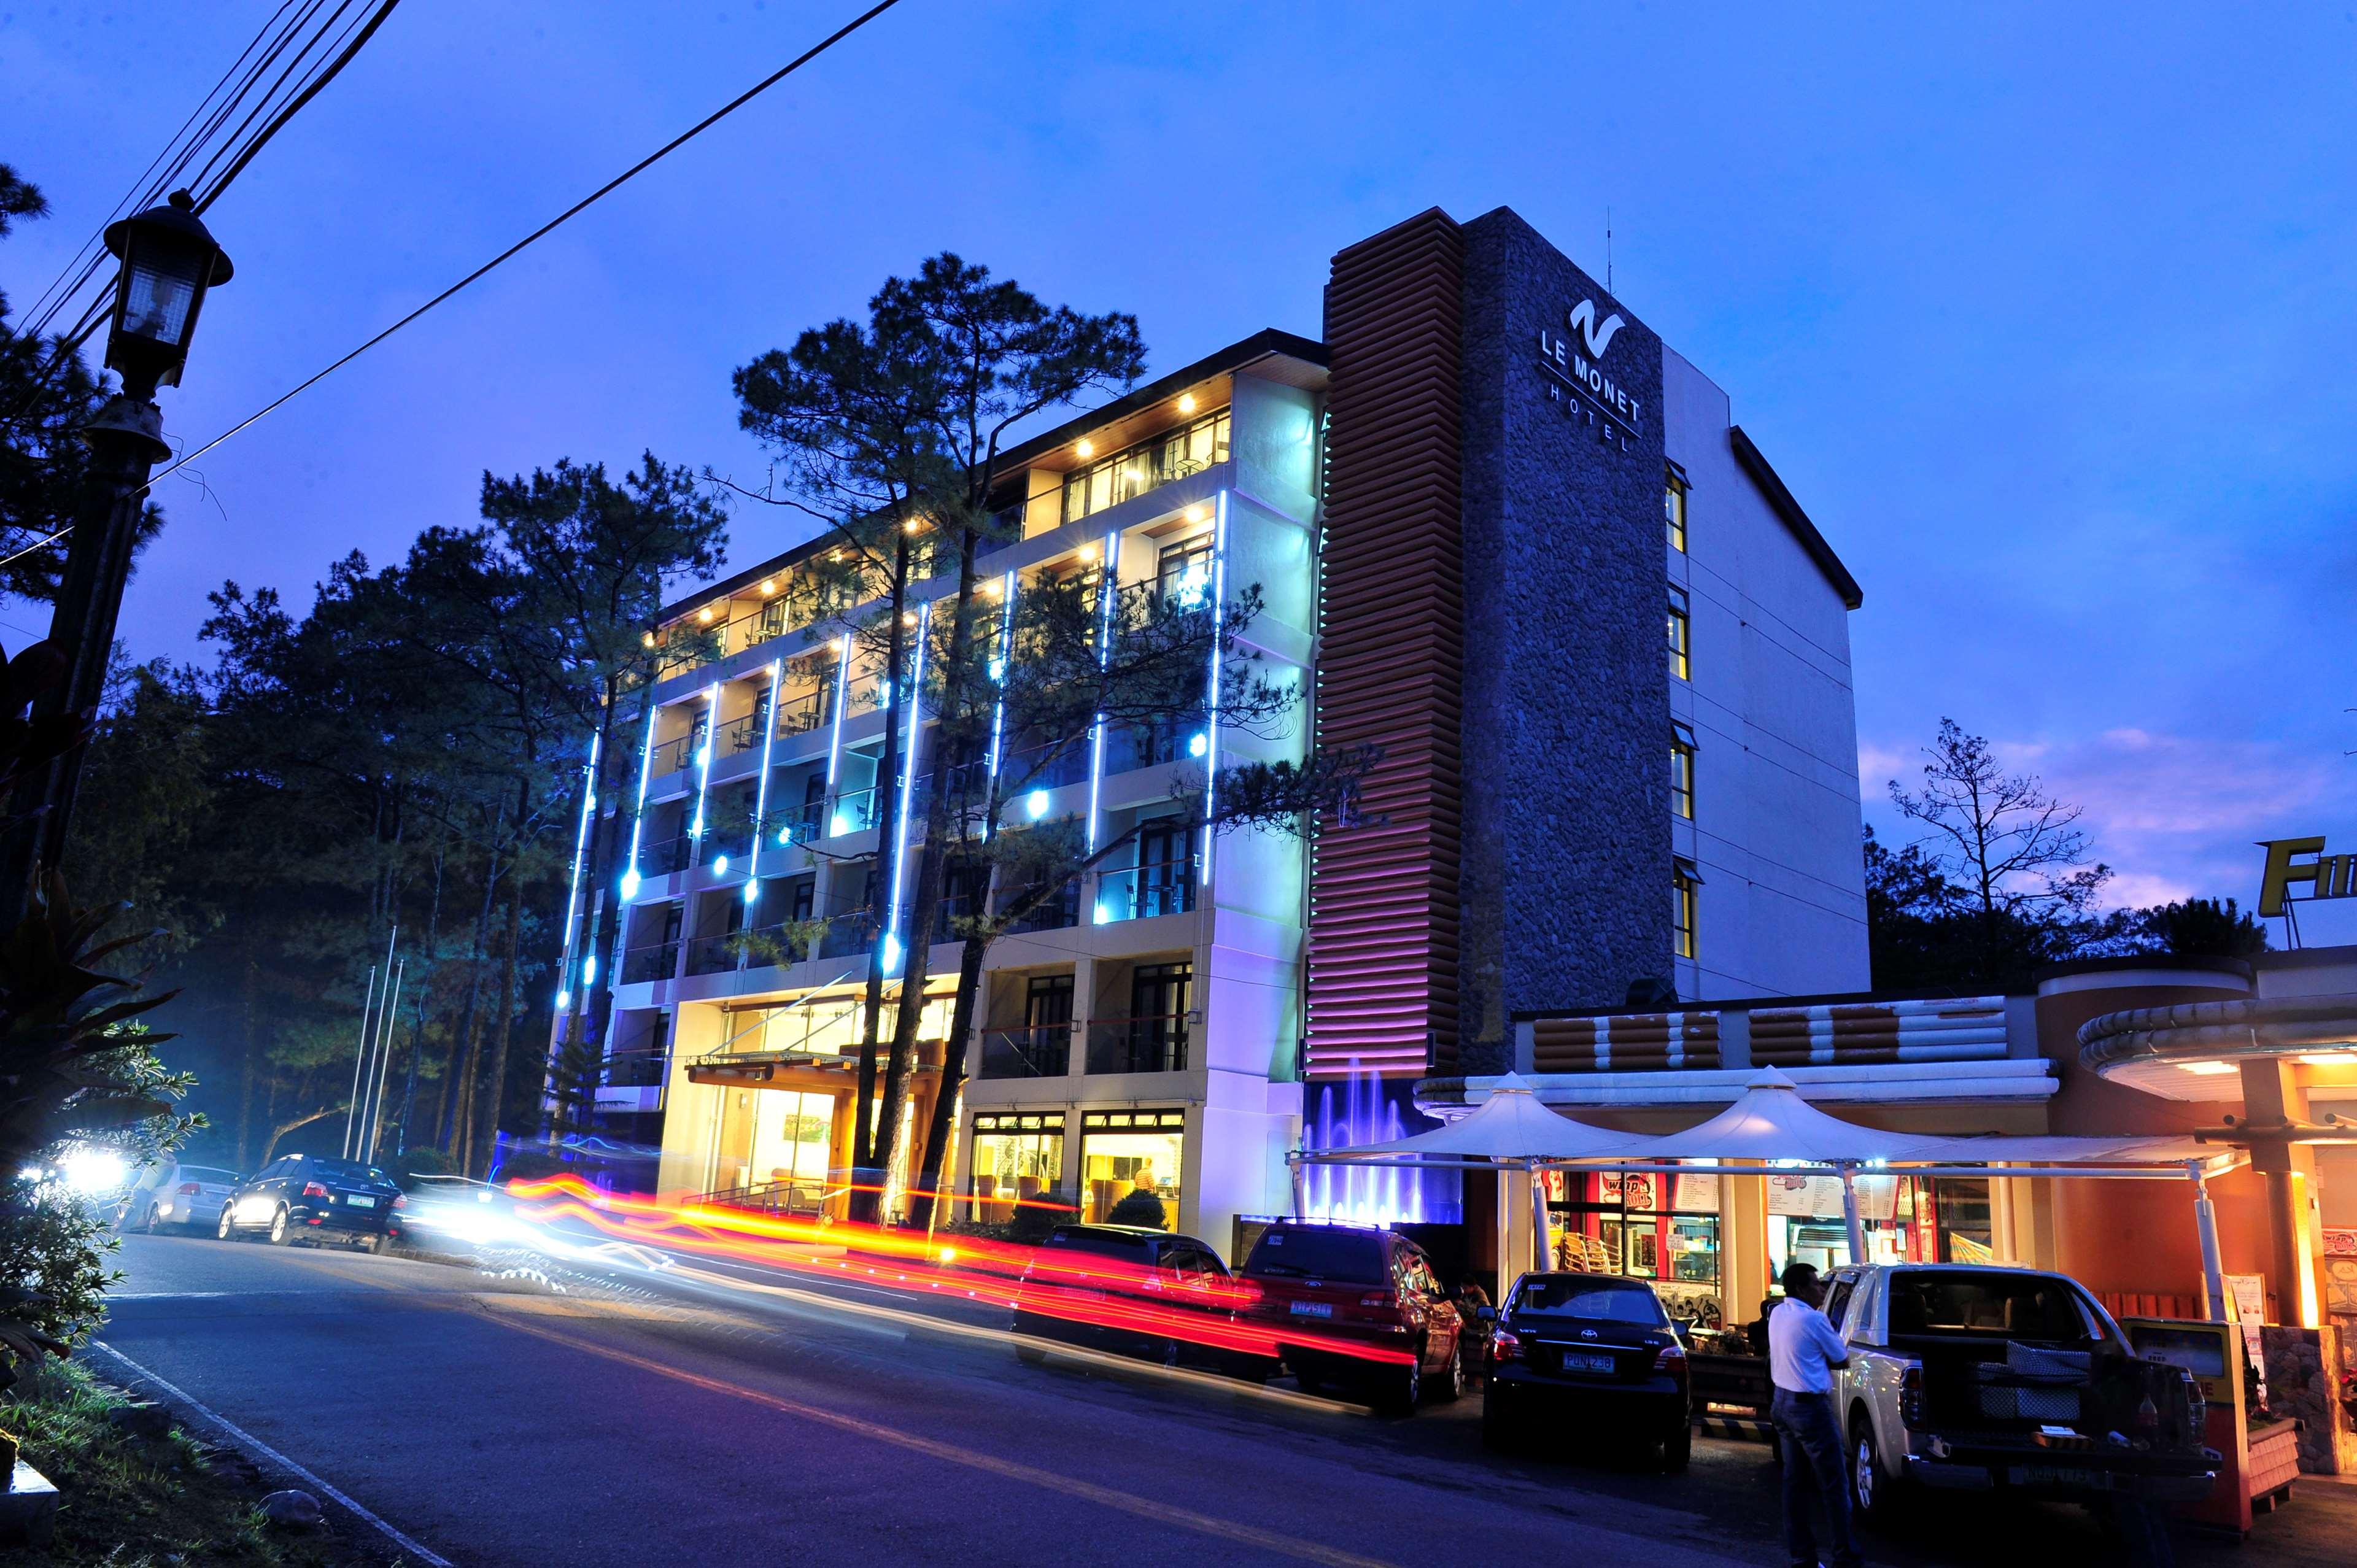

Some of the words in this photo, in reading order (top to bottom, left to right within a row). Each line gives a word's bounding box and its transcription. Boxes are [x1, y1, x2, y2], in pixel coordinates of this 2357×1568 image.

[1542, 330, 1566, 366] LE
[1575, 355, 1639, 422] MONET
[1551, 384, 1628, 452] HOTEL
